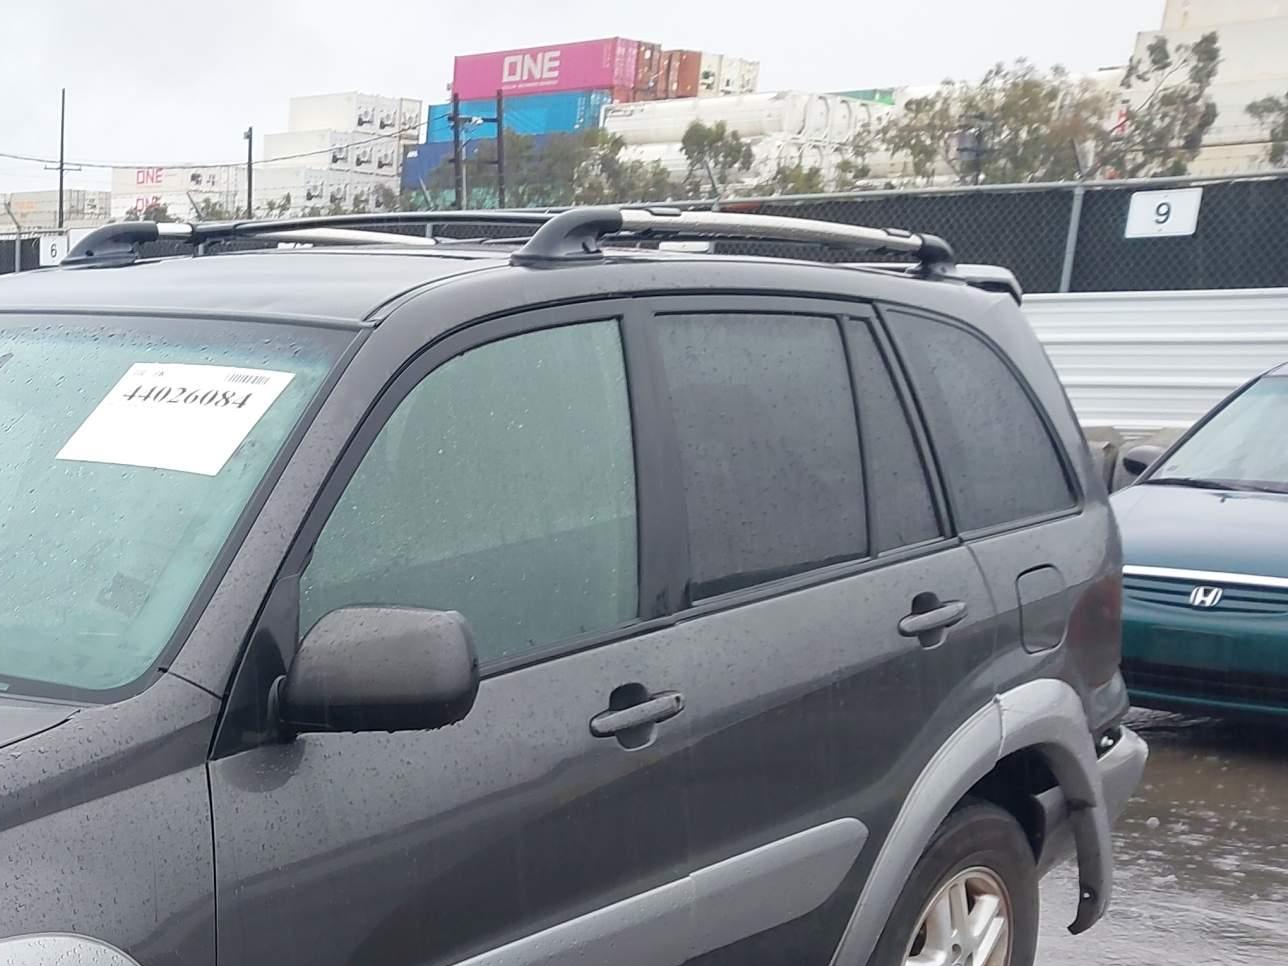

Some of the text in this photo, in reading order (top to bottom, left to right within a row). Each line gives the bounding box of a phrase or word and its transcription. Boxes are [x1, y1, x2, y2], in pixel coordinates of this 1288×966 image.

[502, 50, 561, 83] ONE
[136, 167, 164, 185] ONE
[1155, 202, 1171, 224] 9
[50, 243, 58, 258] 6
[123, 384, 253, 409] 44026084
